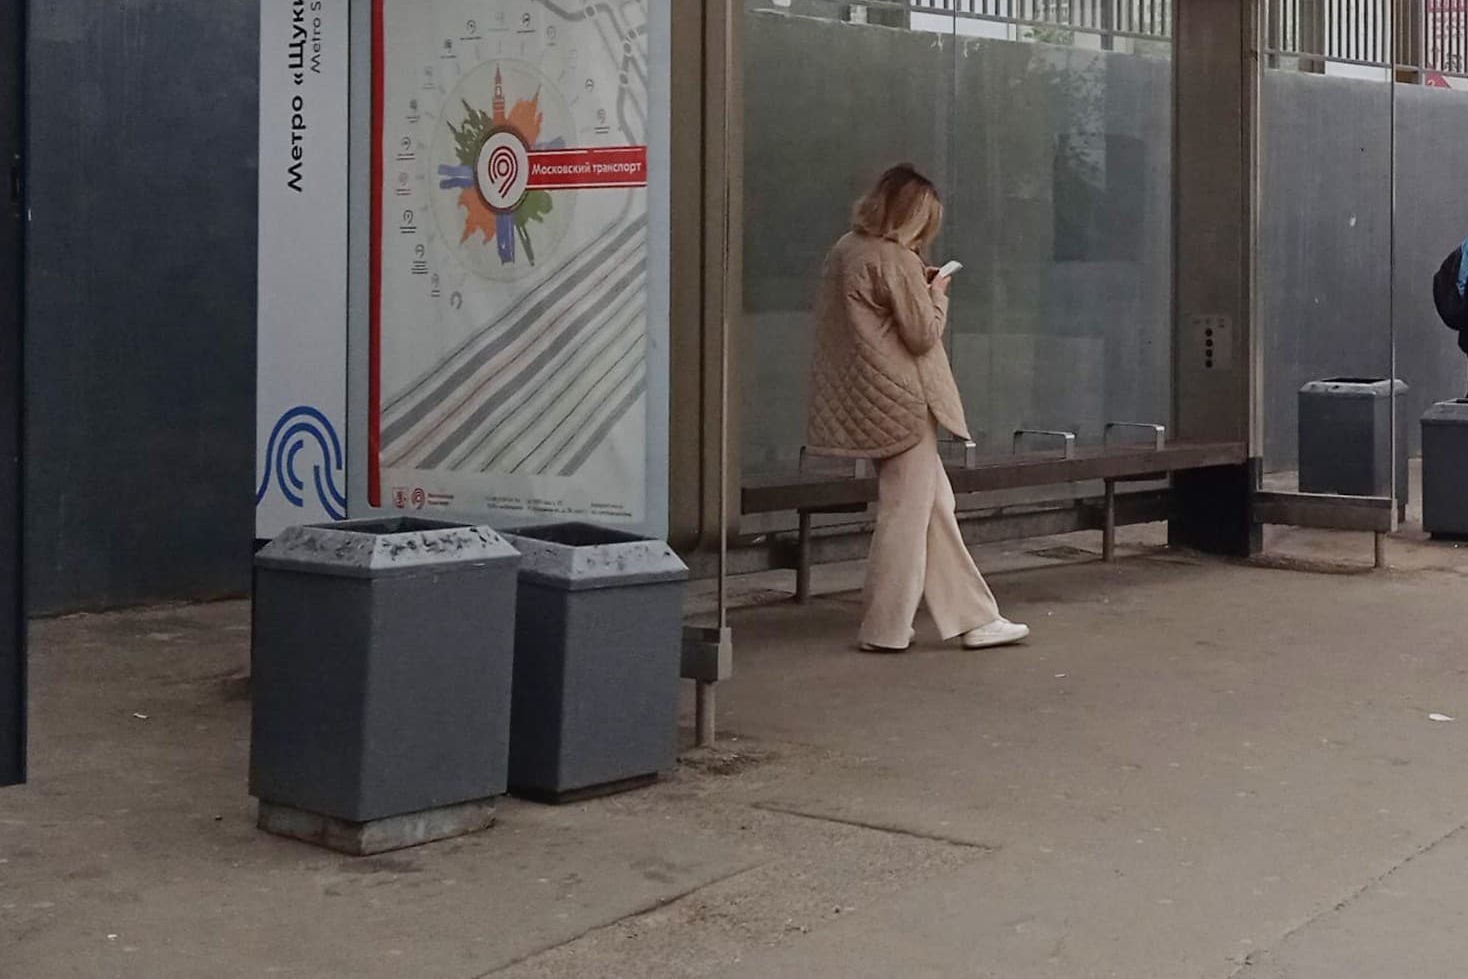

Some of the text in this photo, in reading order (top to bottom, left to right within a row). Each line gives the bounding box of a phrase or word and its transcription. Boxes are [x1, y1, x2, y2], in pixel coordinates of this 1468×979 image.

[310, 16, 323, 75] Metro
[286, 93, 308, 193] Метро
[531, 162, 642, 176] Московский транспорт
